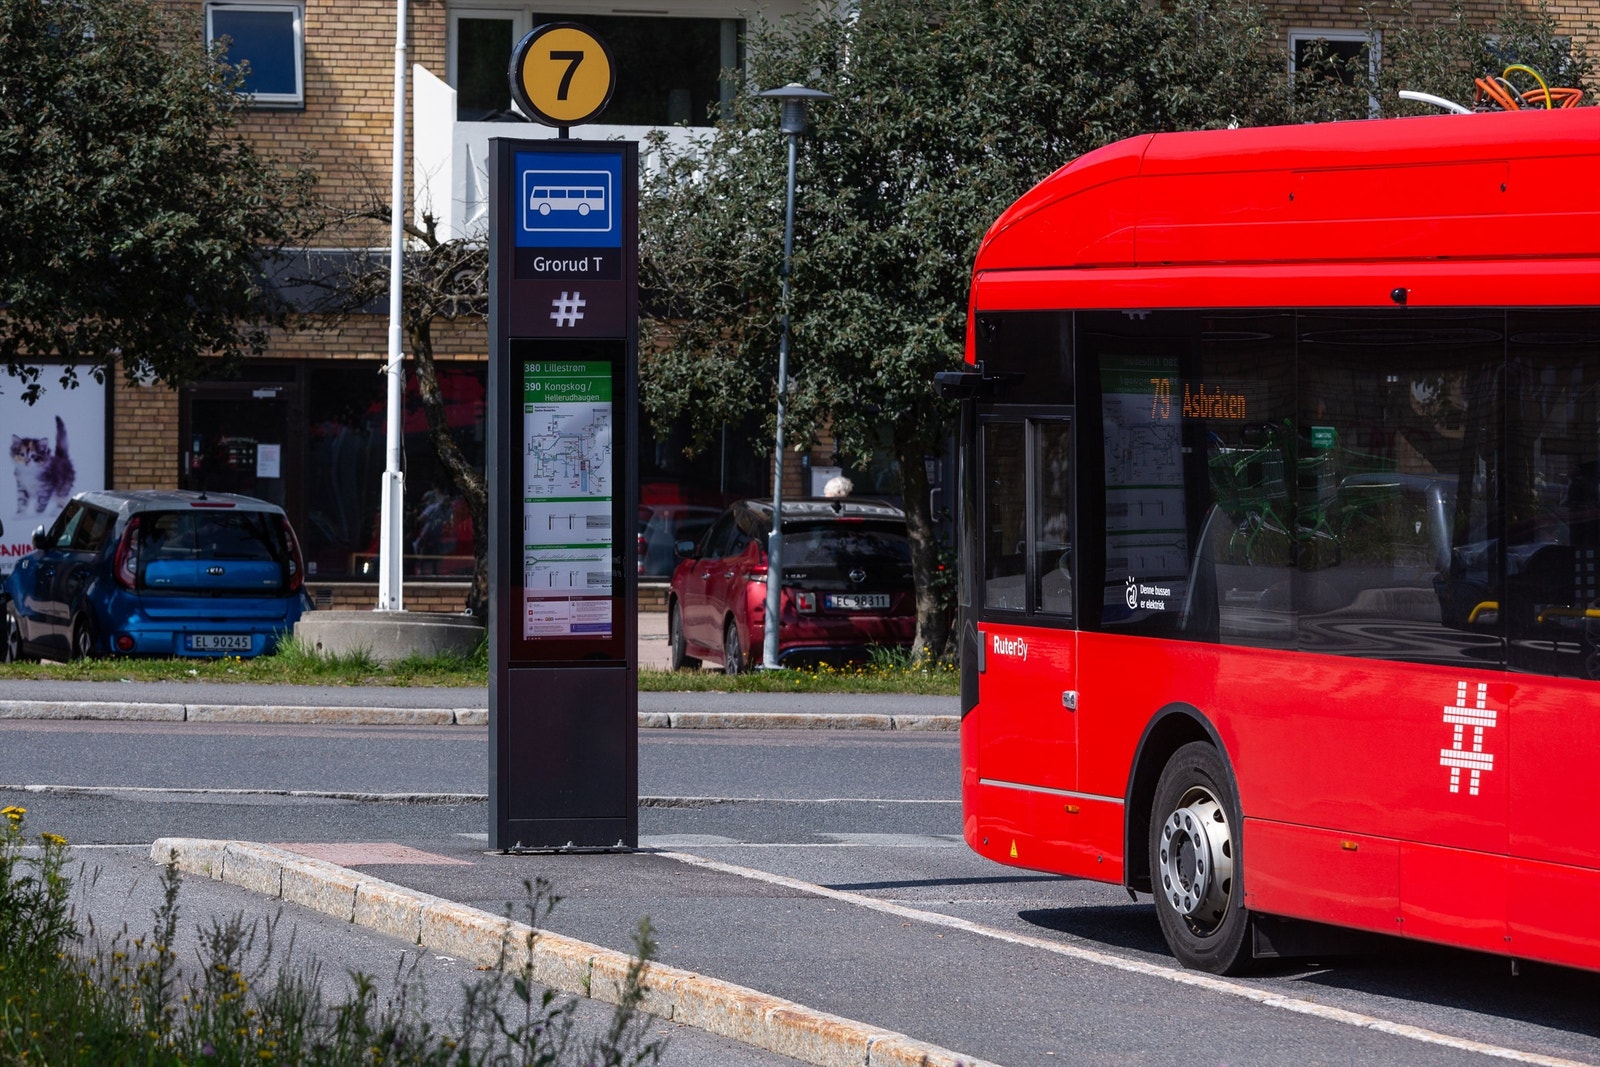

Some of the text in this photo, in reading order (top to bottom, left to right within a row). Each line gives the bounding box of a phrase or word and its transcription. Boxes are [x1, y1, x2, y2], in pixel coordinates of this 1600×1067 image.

[549, 51, 584, 101] 7
[533, 256, 603, 272] Grorud T
[525, 363, 586, 373] 380 Lillestrøm
[525, 382, 541, 391] 390
[545, 382, 586, 392] Kongskog
[545, 394, 600, 403] Hellerudhaugen
[1150, 378, 1169, 419] 79
[1140, 584, 1171, 596] Denne bussen
[800, 596, 812, 609] L
[836, 596, 885, 606] EC 98311
[1140, 599, 1165, 610] er elektrisk
[196, 636, 248, 648] EL 90245
[993, 635, 1028, 661] RuterBy
